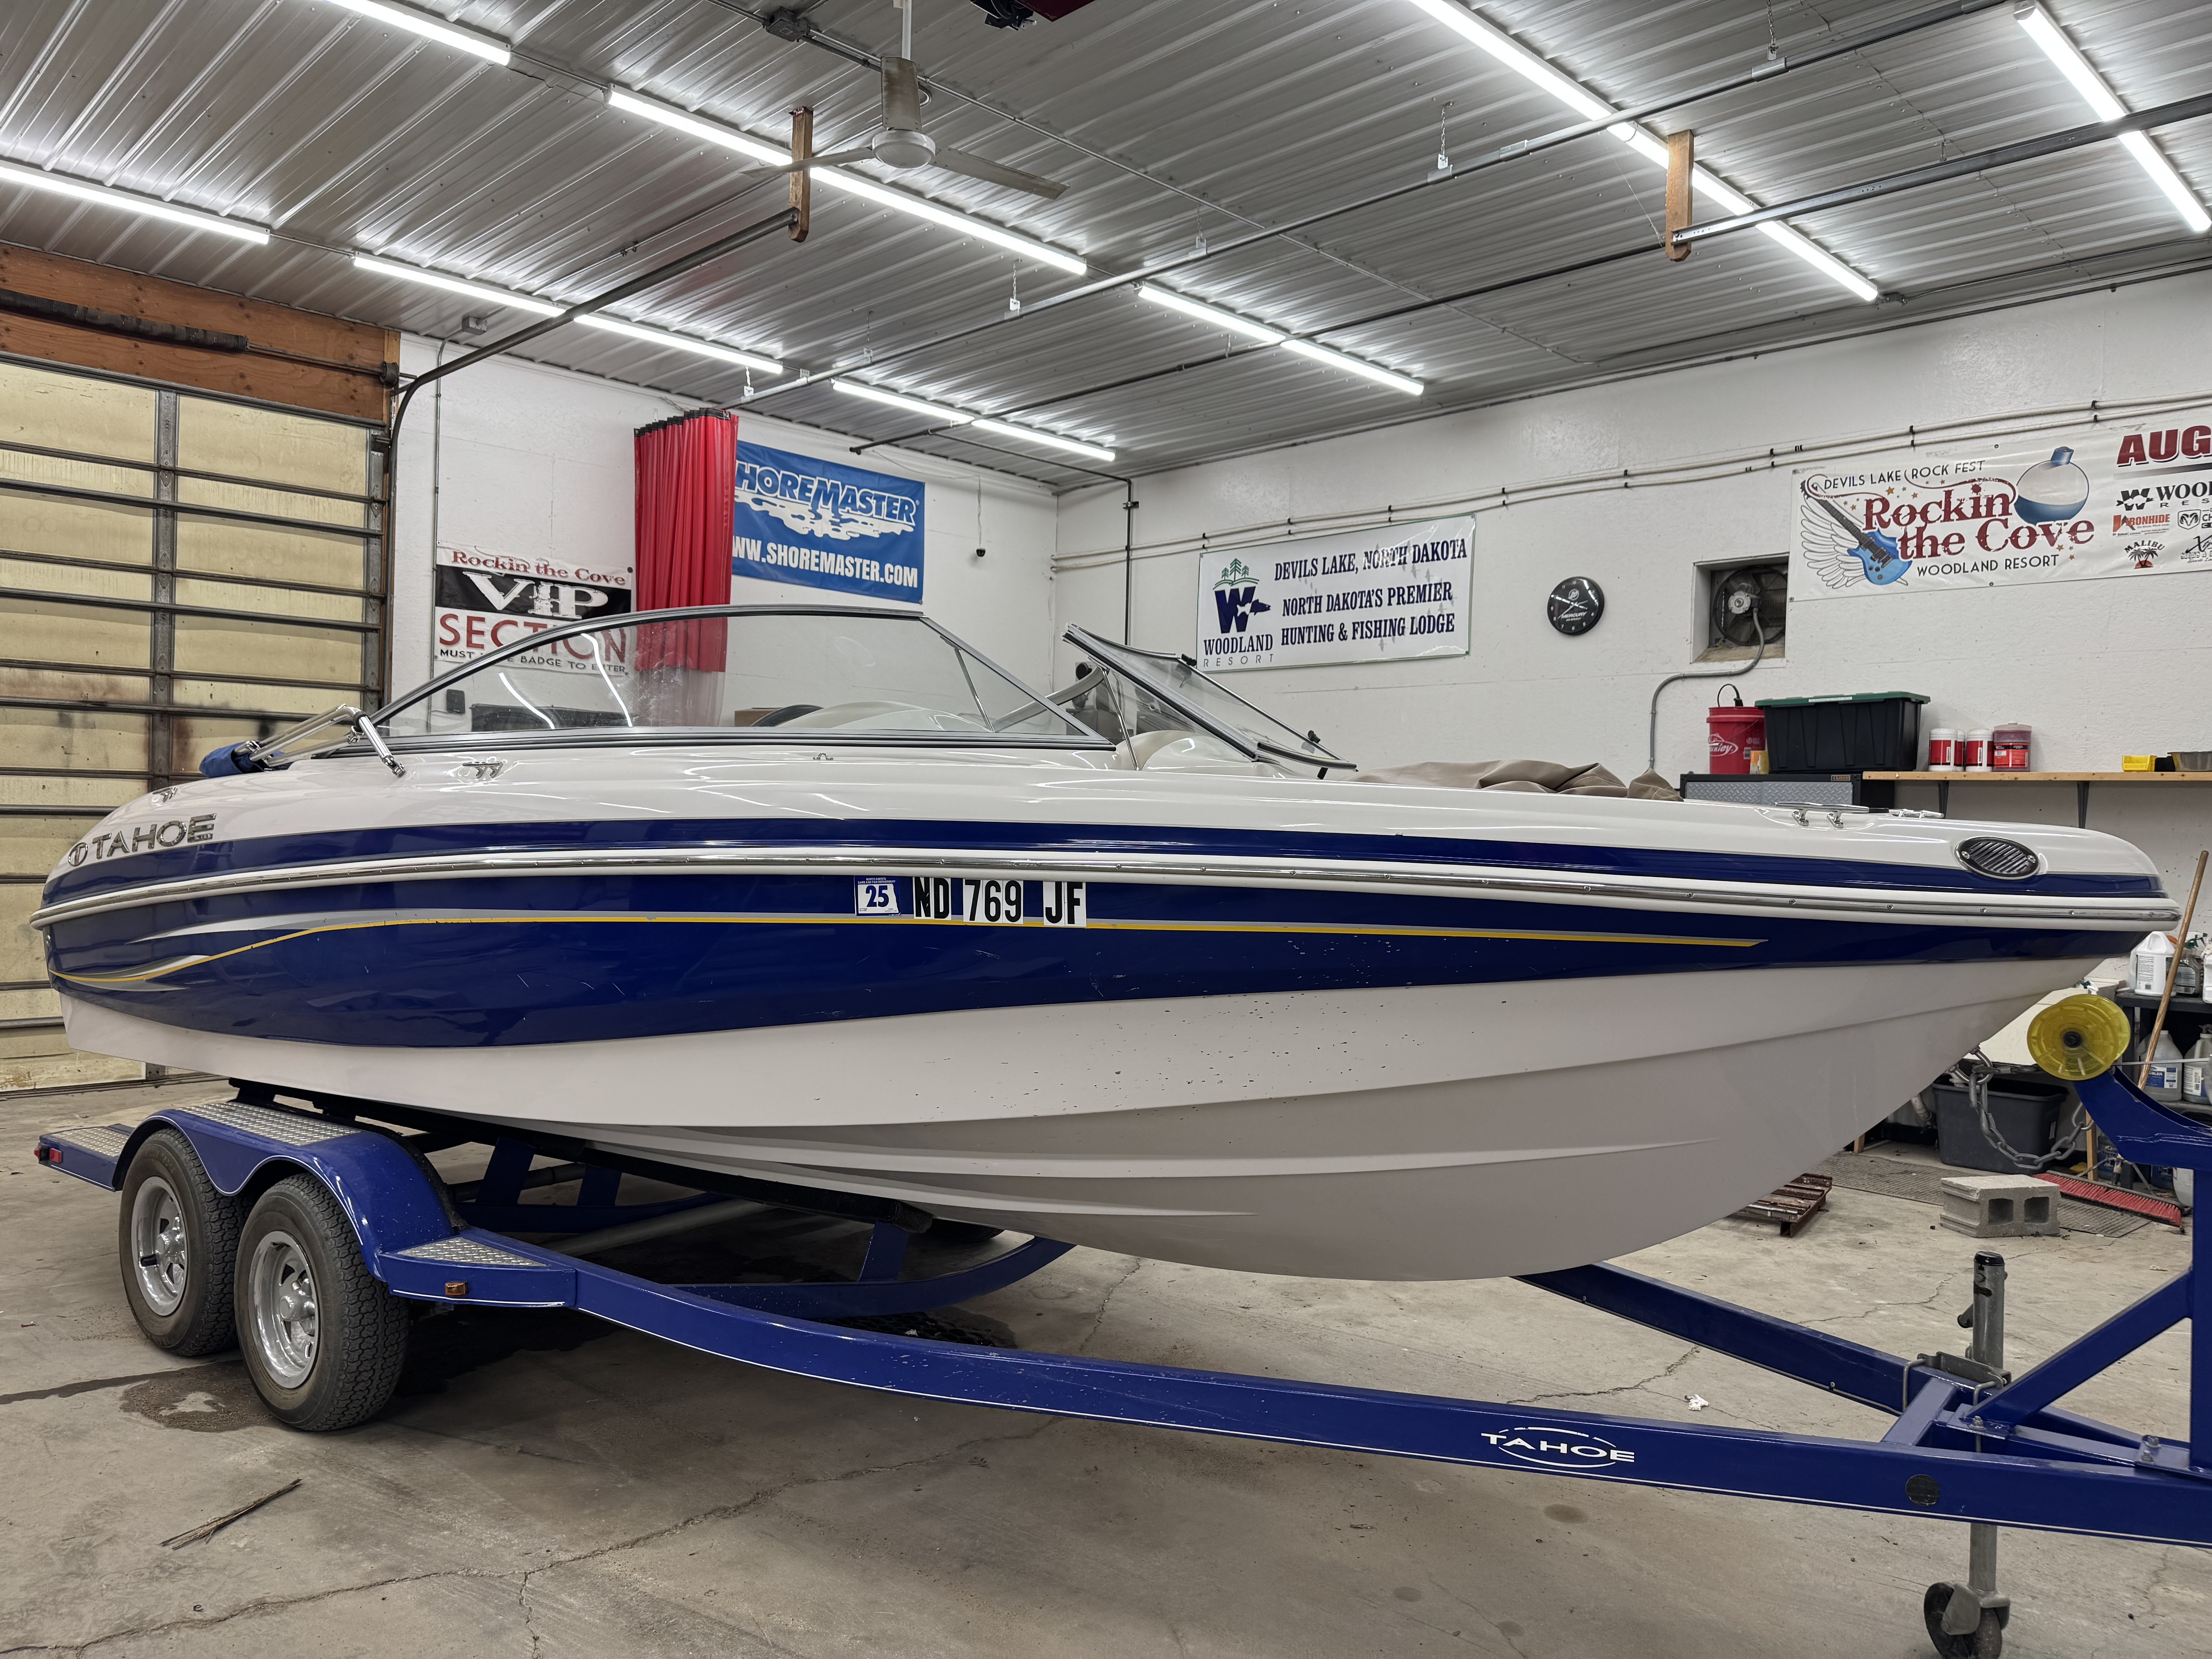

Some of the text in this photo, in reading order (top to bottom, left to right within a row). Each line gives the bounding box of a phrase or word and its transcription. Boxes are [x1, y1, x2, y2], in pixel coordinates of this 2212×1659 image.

[1824, 460, 1986, 490] DEVILS LAKE ROCK FEST
[735, 460, 915, 526] HOREMASTER
[1864, 484, 2013, 531] Rockin
[1898, 518, 2094, 560] the Cove
[2124, 540, 2165, 553] MALIBU
[452, 551, 625, 585] Rockin the Cove
[732, 535, 917, 587] WW.SHOREMASTER.COM
[1274, 538, 1467, 581] DEVILS LAKE, NORTH DAKOTA
[1917, 554, 2059, 577] WOODLAND RESORT
[463, 572, 608, 620] VIP
[1282, 581, 1453, 617] NORTH DAKOTA'S PREMIER
[1204, 634, 1273, 656] WOODLAND
[1281, 613, 1455, 646] HUNTING & FISHING LODGE
[440, 649, 474, 659] MUST
[521, 656, 561, 667] BADGE
[568, 661, 586, 669] TO
[592, 663, 625, 672] ETER
[1204, 654, 1273, 667] RESORT
[92, 813, 216, 860] TAHOE
[866, 885, 889, 907] 25
[915, 877, 1083, 924] ND 769 JF
[1481, 1432, 1635, 1462] TAHOE
